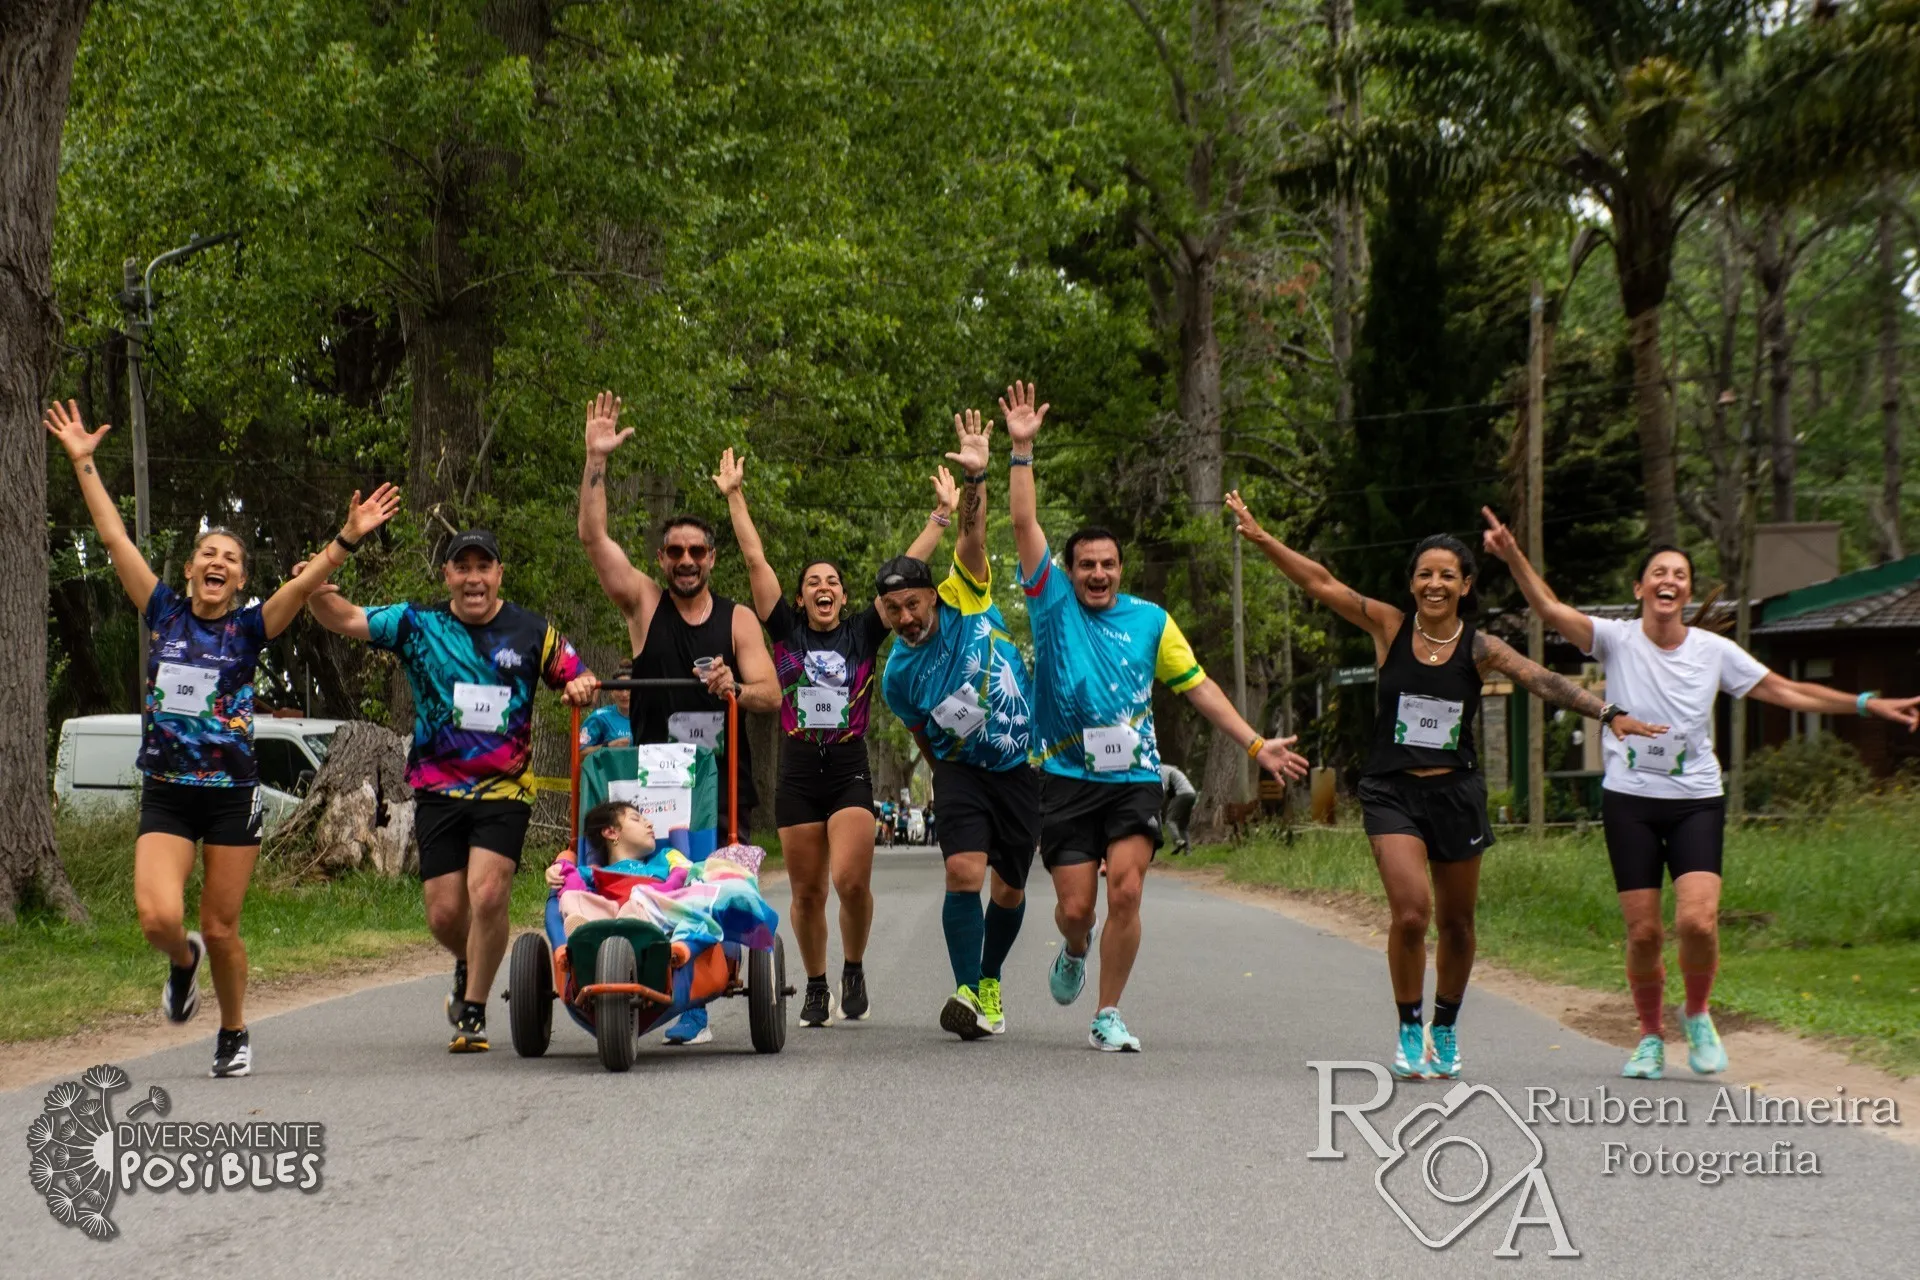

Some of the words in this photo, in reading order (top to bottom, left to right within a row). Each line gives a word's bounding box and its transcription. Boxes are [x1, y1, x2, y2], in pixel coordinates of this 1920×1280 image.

[176, 684, 194, 696] 109
[475, 702, 490, 713] 123
[815, 703, 831, 713] 088
[954, 706, 969, 721] 114
[1420, 717, 1439, 729] 001
[689, 728, 704, 739] 101
[1105, 744, 1121, 754] 013
[1647, 745, 1665, 757] 108
